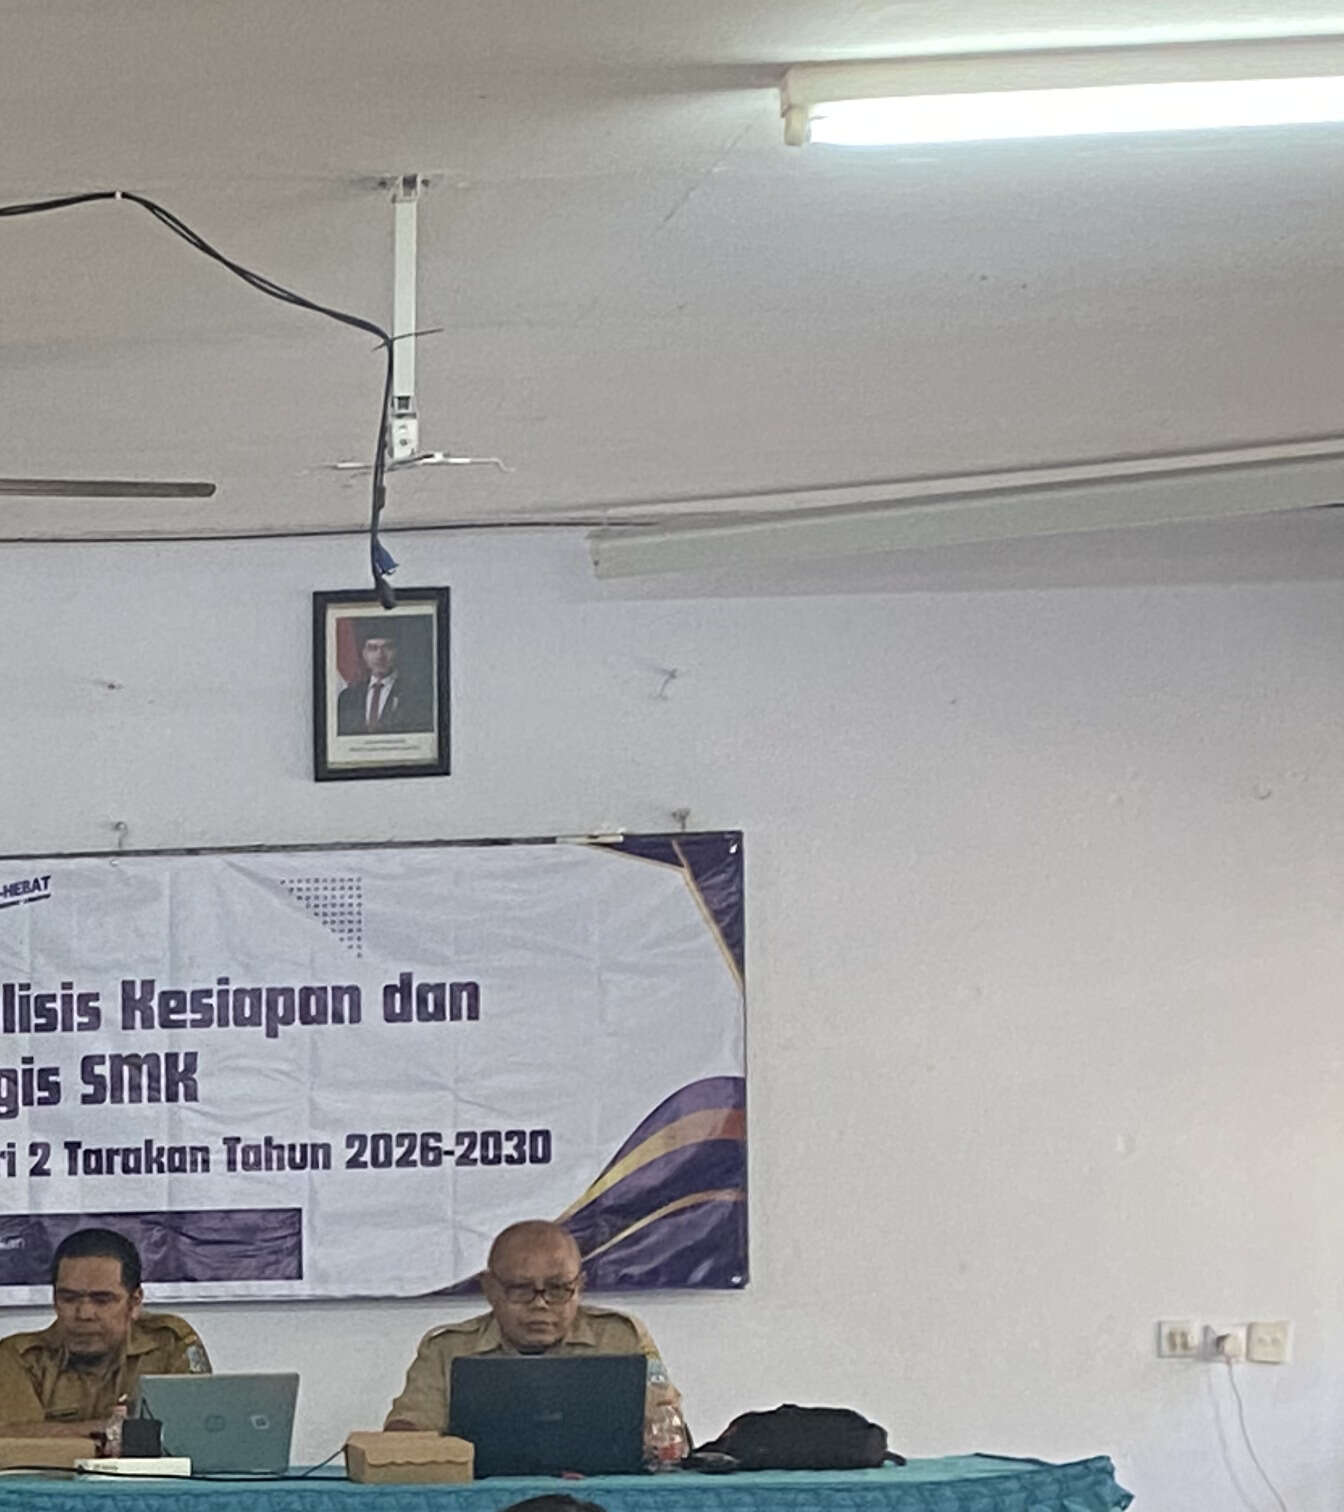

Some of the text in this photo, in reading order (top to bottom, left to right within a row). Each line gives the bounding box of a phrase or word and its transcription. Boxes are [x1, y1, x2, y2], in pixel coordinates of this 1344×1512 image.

[121, 977, 361, 1038] Kesiapan
[383, 972, 480, 1023] dan
[81, 1052, 198, 1105] SMK
[29, 1142, 51, 1177] 2
[64, 1139, 210, 1176] Tarakan
[223, 1136, 331, 1172] Tahun
[346, 1129, 551, 1169] 2026-2030
